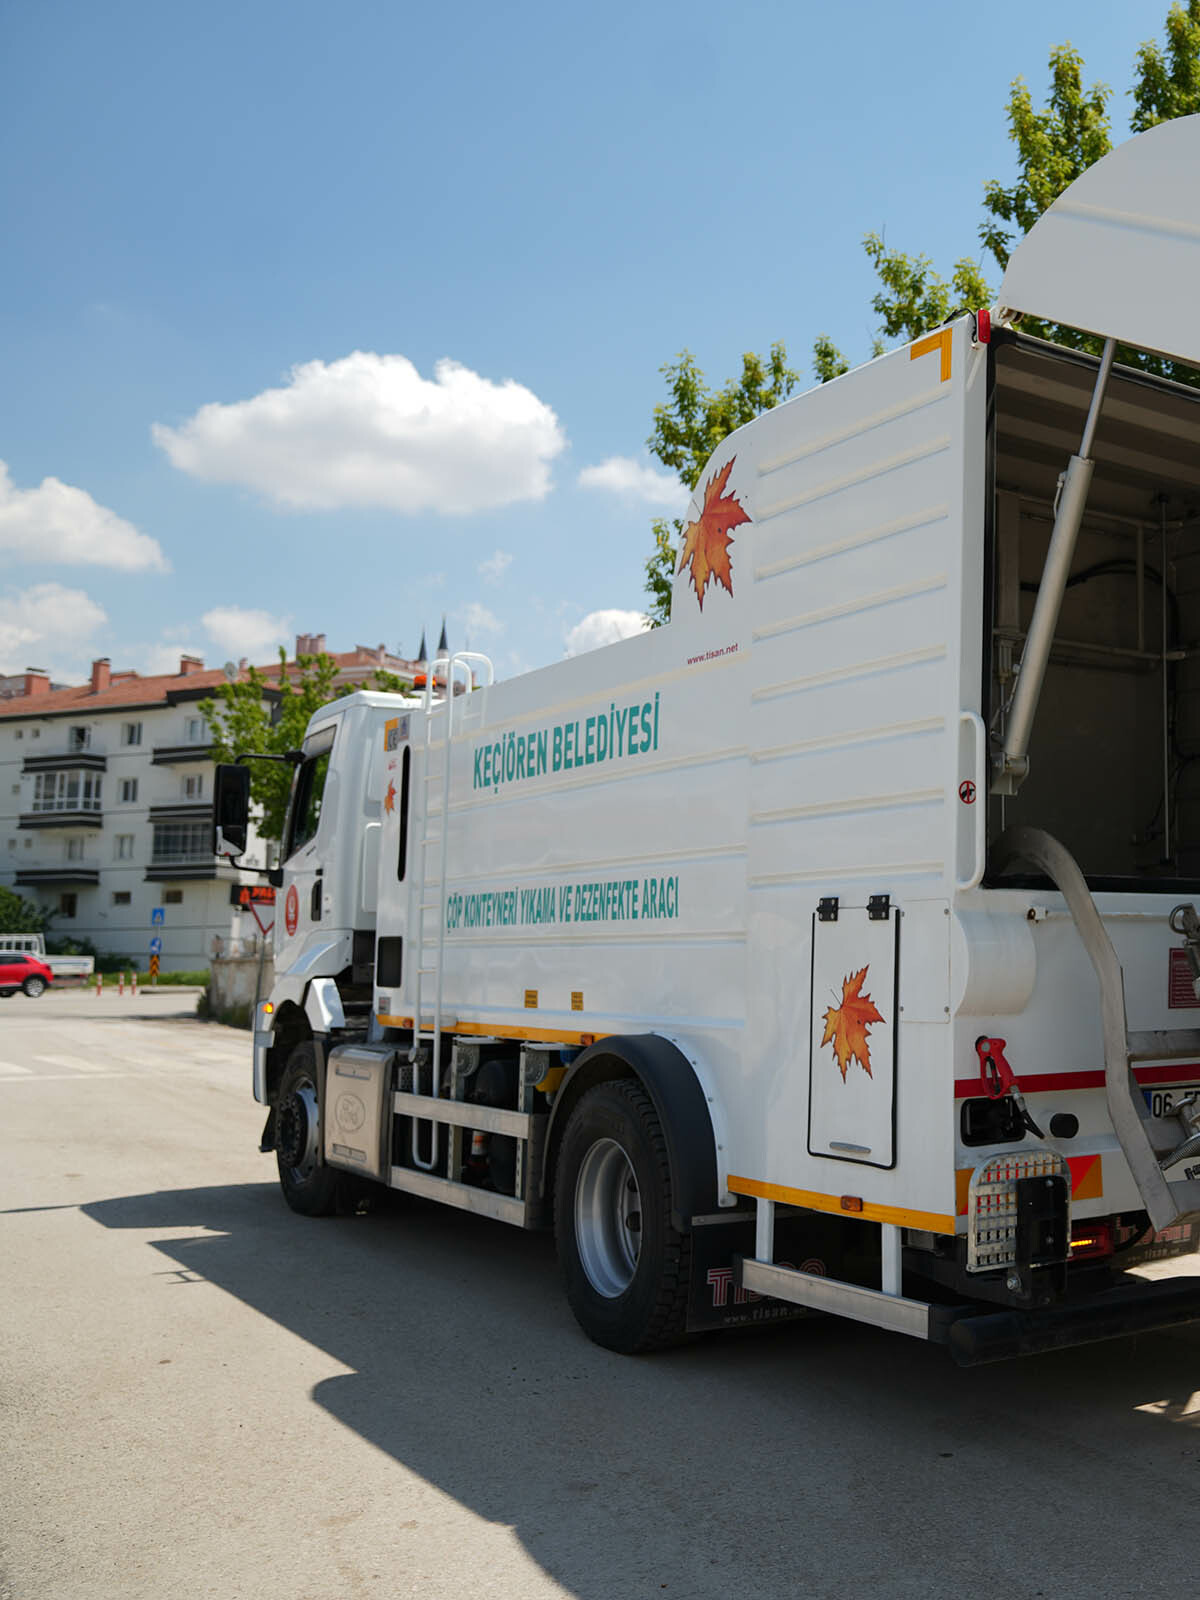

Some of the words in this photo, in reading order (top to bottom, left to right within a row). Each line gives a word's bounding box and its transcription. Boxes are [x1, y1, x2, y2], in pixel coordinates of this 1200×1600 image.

[687, 642, 738, 665] www.tisan.net
[473, 730, 548, 794] KEÇİÖREN
[552, 692, 660, 772] BELEDİYESİ
[447, 891, 463, 934] ÇÖP
[464, 887, 519, 928] KONTEYNERİ
[521, 887, 556, 925] YIKAMA
[559, 885, 573, 923] VE
[574, 880, 639, 922] DEZENFEKTE
[641, 875, 679, 919] ARACI
